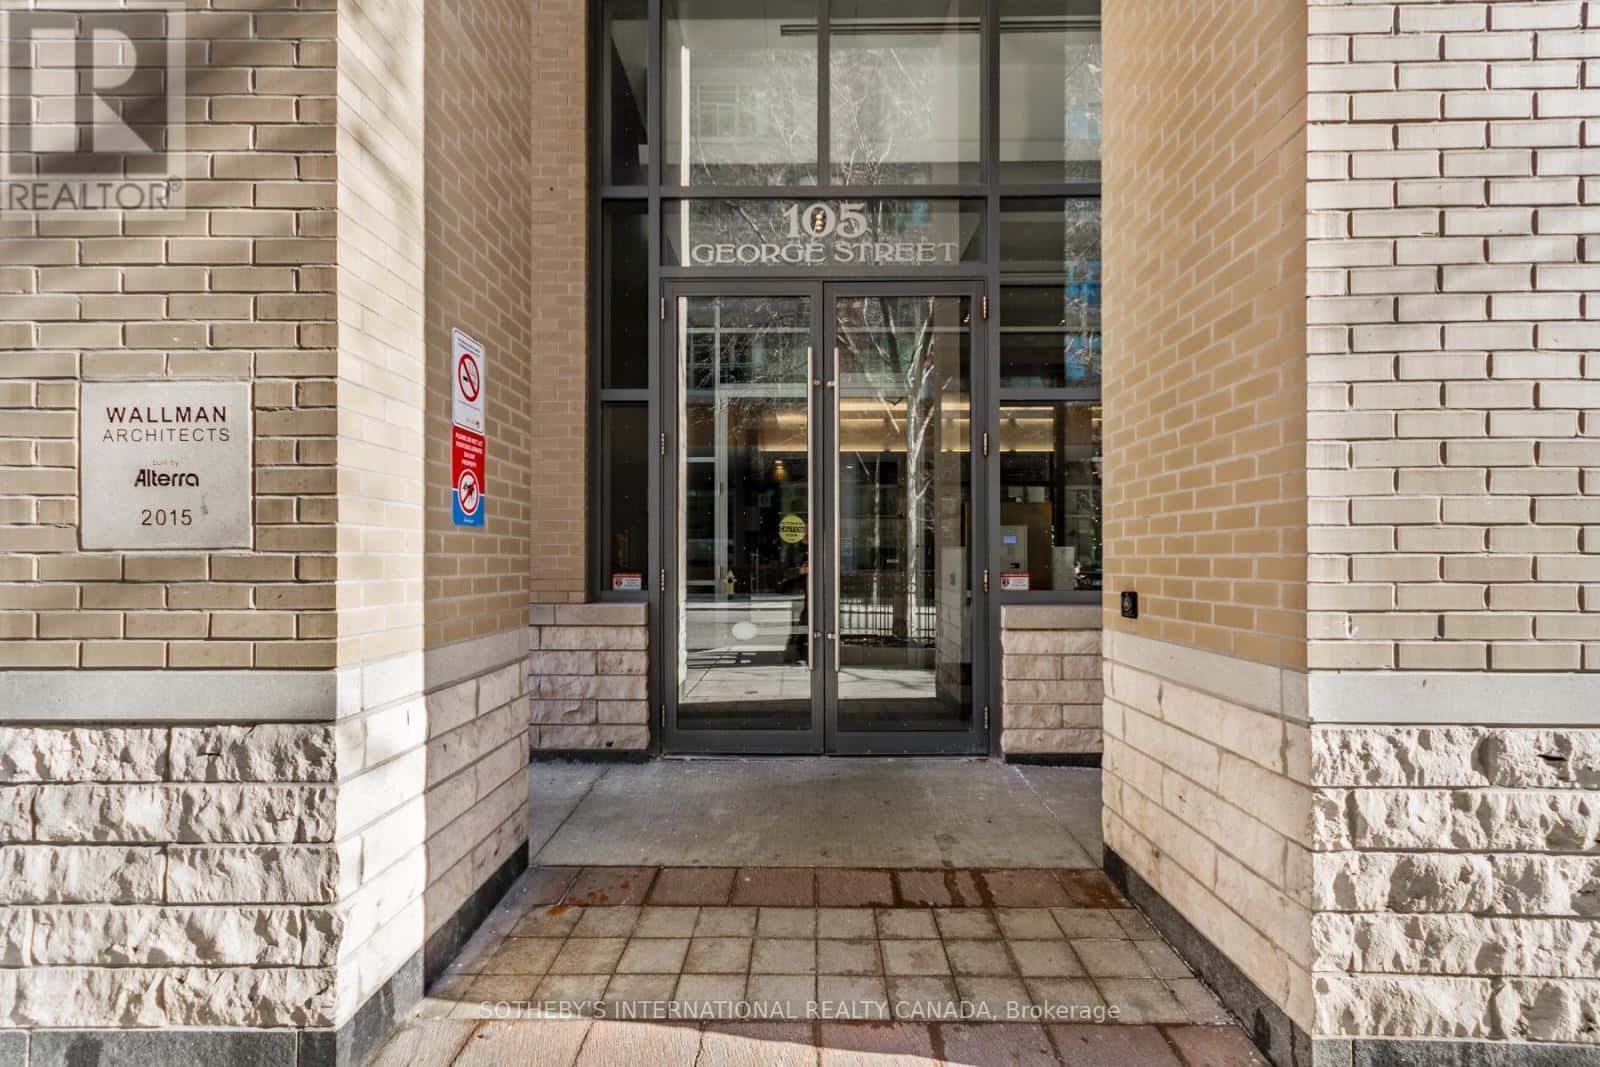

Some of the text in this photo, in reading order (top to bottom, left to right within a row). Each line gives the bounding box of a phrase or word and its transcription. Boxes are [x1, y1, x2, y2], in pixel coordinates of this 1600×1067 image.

[784, 203, 867, 238] 105
[691, 242, 959, 264] GEORGE STREET
[106, 406, 227, 423] WALLMAN
[102, 428, 231, 442] ARCHITECTS
[134, 469, 200, 487] Alterra
[141, 509, 193, 526] 2015
